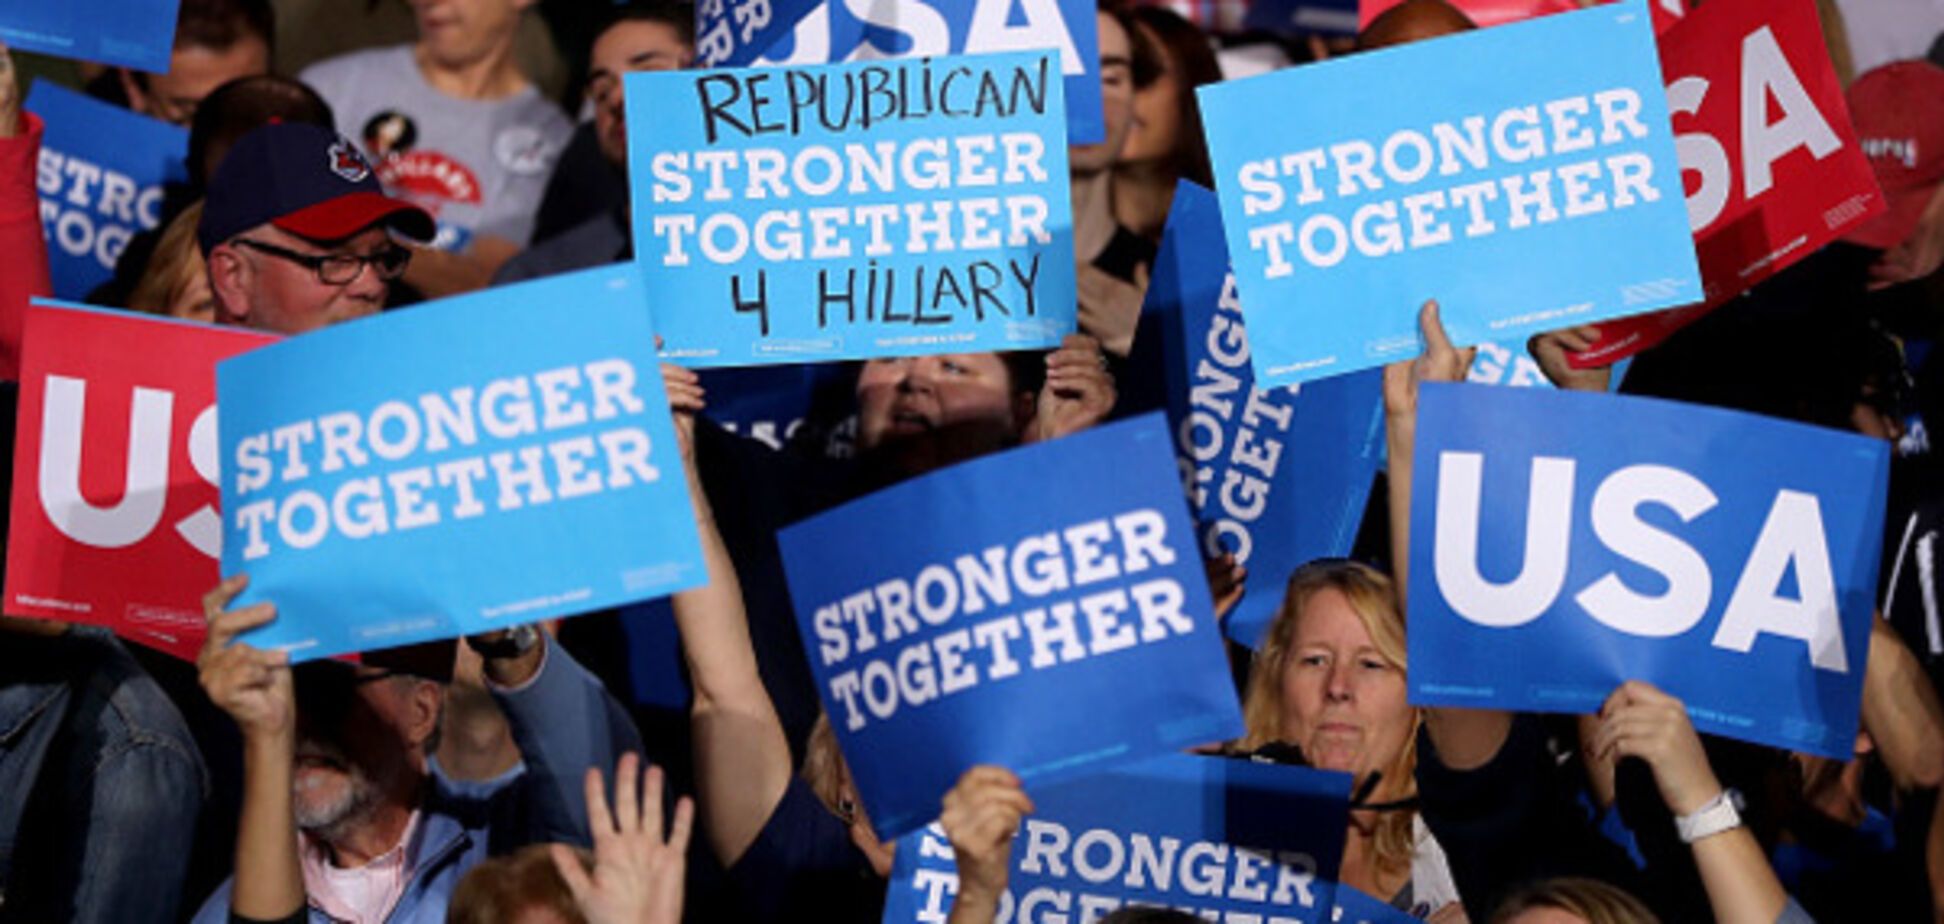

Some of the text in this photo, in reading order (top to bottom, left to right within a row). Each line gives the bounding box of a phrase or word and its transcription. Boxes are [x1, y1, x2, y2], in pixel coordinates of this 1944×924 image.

[652, 132, 1048, 203] STRONGER
[1238, 88, 1649, 216] STRONGER
[1249, 152, 1661, 279] TOGETHER
[653, 195, 1051, 266] TOGETHER
[731, 269, 769, 337] 4
[237, 358, 644, 493] STRONGER
[1206, 384, 1300, 567] OGET
[237, 428, 660, 559] TOGETHER
[815, 509, 1176, 664] STRONGER
[1434, 450, 1848, 674] USA
[832, 578, 1194, 728] TOGETHER
[918, 820, 1316, 908] SRONGER
